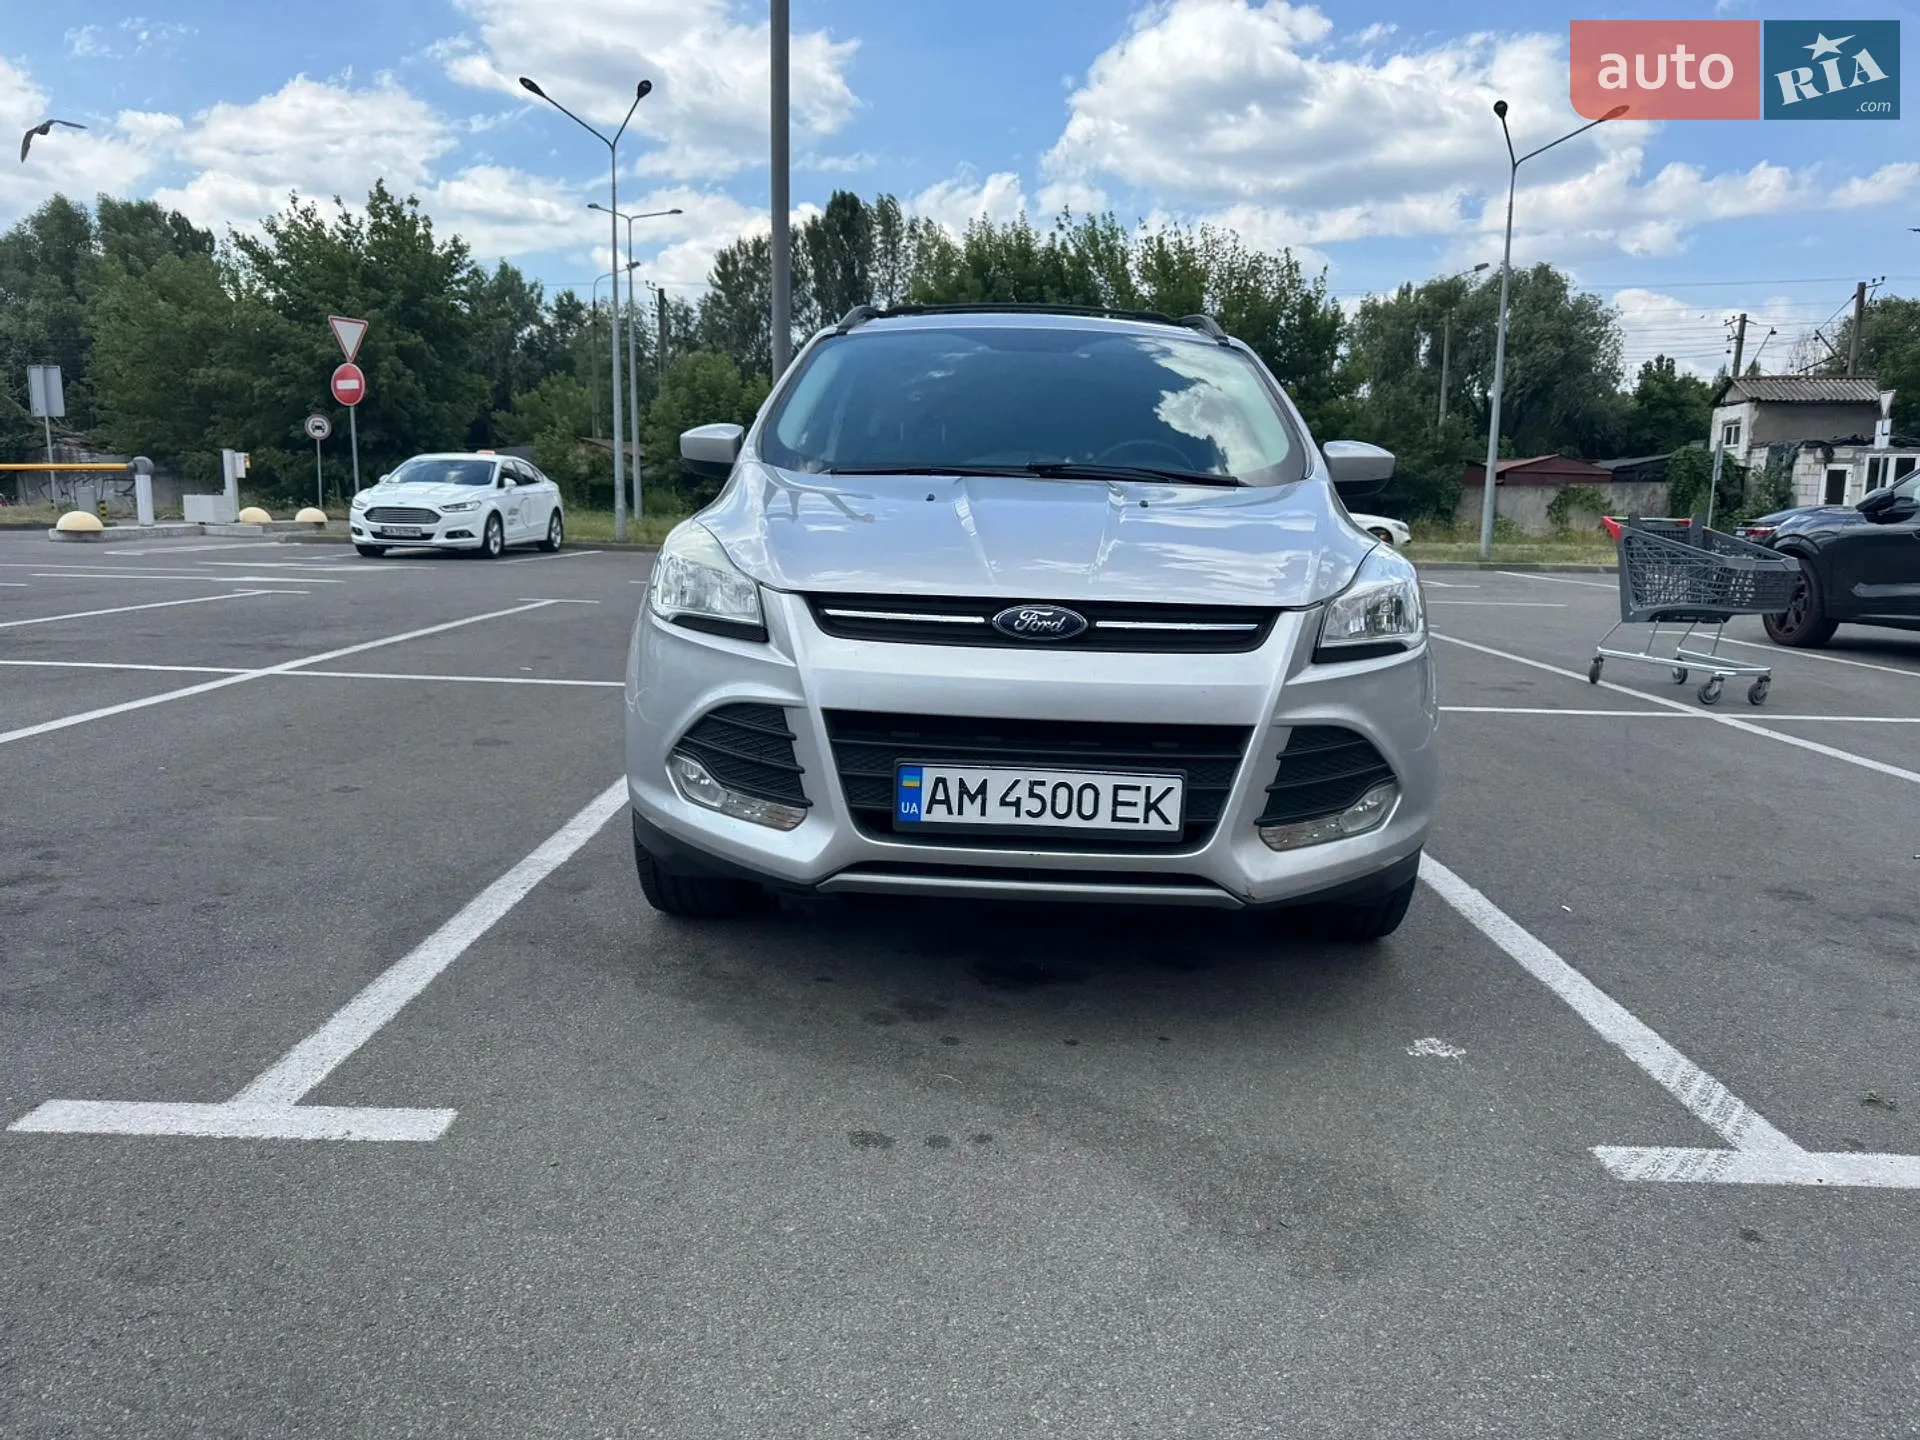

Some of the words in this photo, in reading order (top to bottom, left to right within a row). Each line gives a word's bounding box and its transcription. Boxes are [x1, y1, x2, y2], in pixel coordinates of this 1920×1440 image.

[1014, 609, 1067, 632] Ford
[901, 801, 919, 814] UA
[925, 776, 988, 817] AM
[999, 778, 1100, 821] 4500
[1111, 784, 1175, 825] EK
